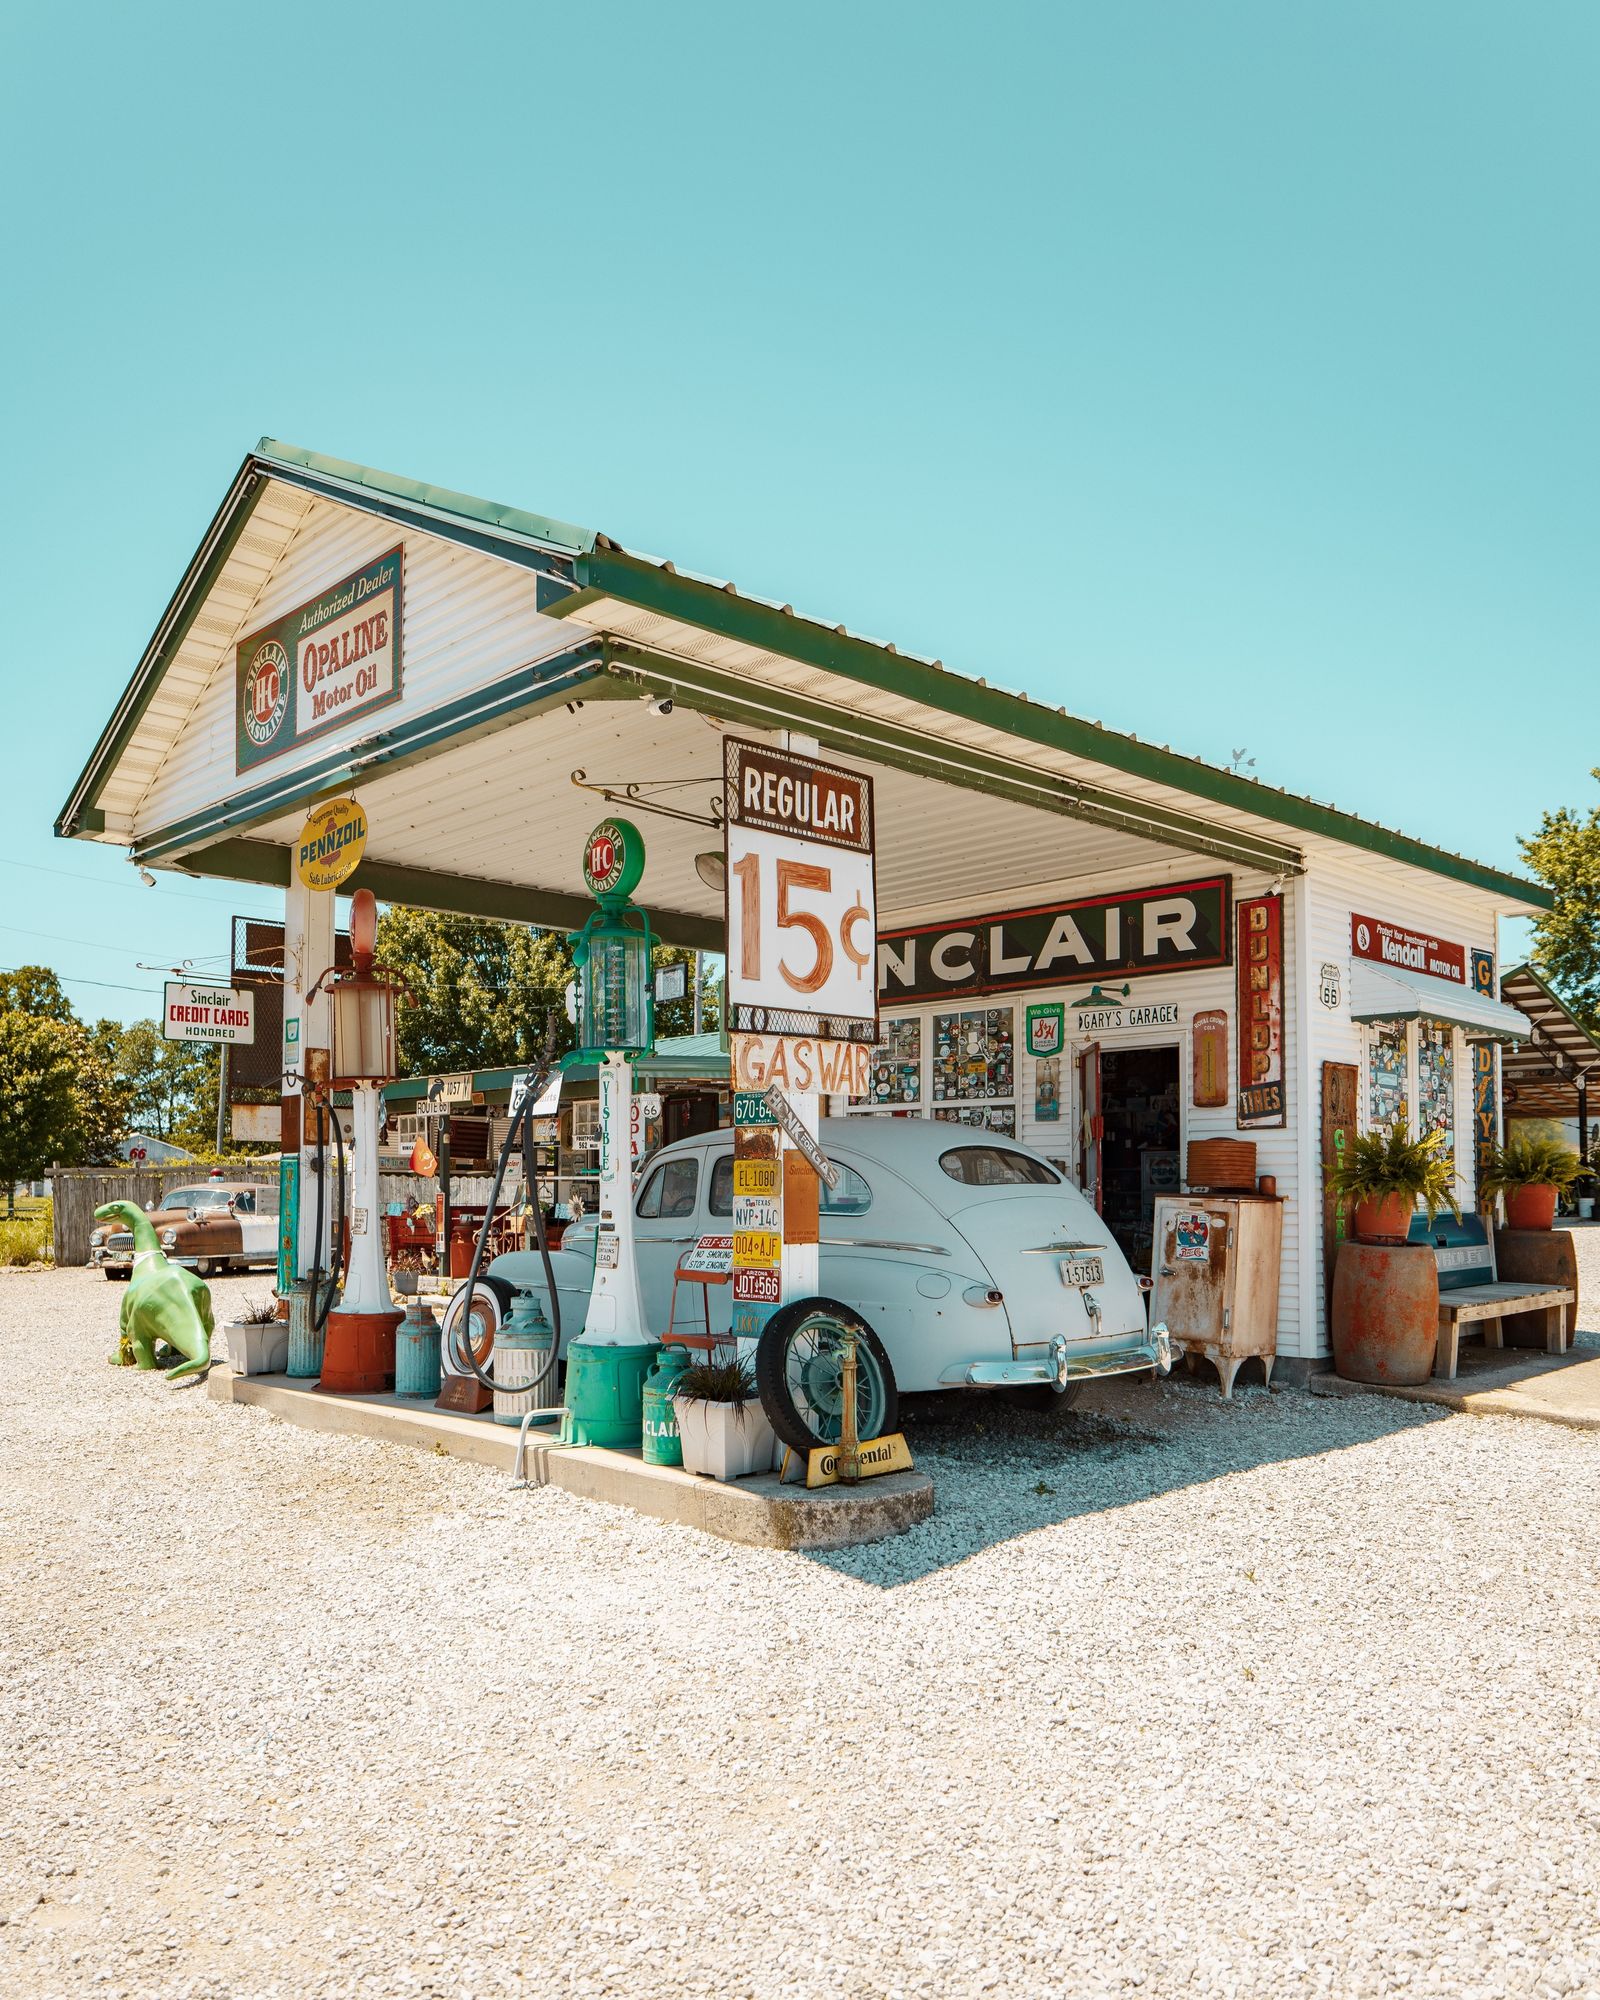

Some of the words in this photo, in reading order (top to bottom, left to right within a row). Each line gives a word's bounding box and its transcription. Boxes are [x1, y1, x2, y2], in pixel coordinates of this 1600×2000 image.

[299, 584, 354, 634] Authorized
[357, 566, 394, 600] Dealer
[303, 609, 388, 693] OPALINE
[247, 643, 287, 691] SINCLAIR
[312, 682, 353, 720] Motor
[356, 664, 377, 697] Oil
[246, 692, 287, 742] GASOLINE
[744, 766, 854, 834] REGULAR
[300, 817, 365, 867] PENNZOIL
[586, 826, 622, 855] SINCLAIR
[309, 871, 320, 885] Safe
[321, 862, 352, 885] Lubrication
[585, 860, 623, 891] GASOLINE
[1377, 924, 1393, 937] Protect
[1394, 929, 1403, 940] Your
[1404, 933, 1427, 947] Investment
[1429, 941, 1438, 950] with
[1382, 936, 1425, 969] Kendall
[1430, 959, 1450, 976] MOTOR
[1452, 965, 1461, 979] OIL
[191, 990, 231, 1007] Sinclair
[1250, 906, 1270, 1080] DUNLOP
[1324, 988, 1337, 1005] 66
[170, 1005, 210, 1024] CREDIT
[213, 1008, 249, 1027] CARDS
[1084, 1011, 1122, 1029] GARY'S
[1129, 1006, 1172, 1025] GARAGE
[185, 1026, 235, 1039] HONORED
[418, 1102, 437, 1114] ROUTE
[644, 1105, 657, 1116] 66
[1241, 1086, 1280, 1114] TIRES
[130, 1148, 147, 1160] 66
[800, 1135, 815, 1154] FOR
[706, 1261, 728, 1269] ENGINE
